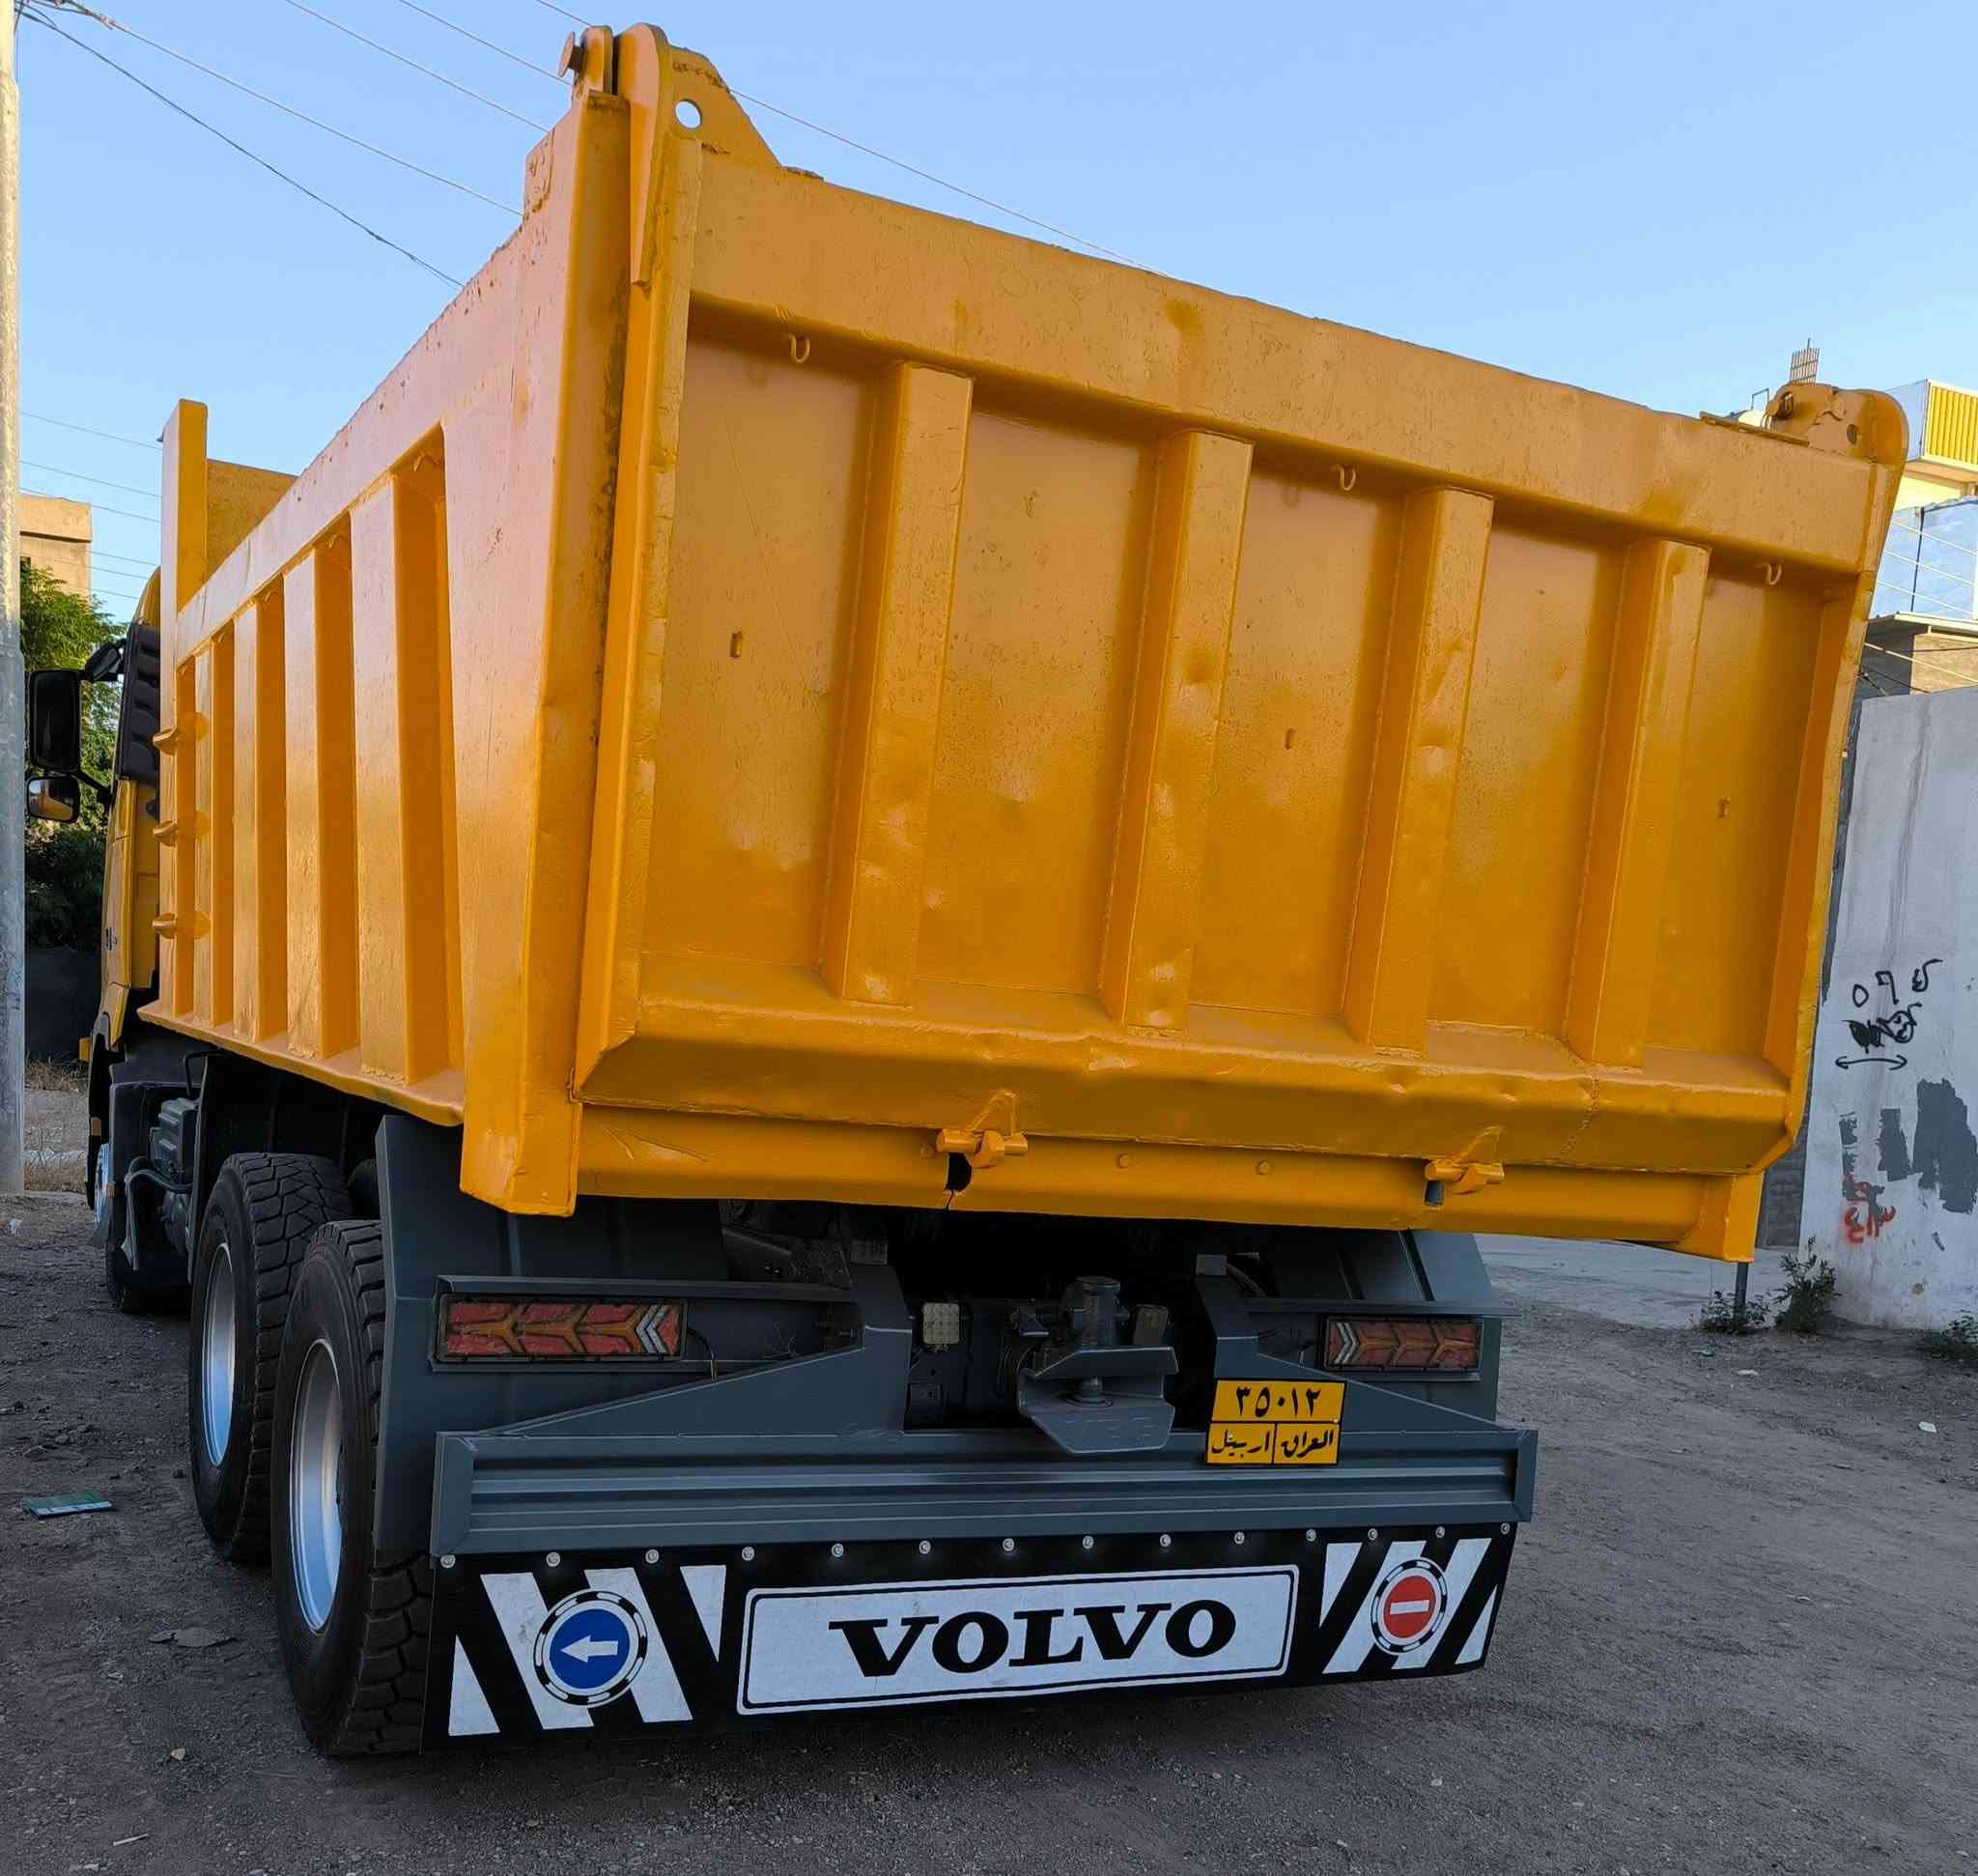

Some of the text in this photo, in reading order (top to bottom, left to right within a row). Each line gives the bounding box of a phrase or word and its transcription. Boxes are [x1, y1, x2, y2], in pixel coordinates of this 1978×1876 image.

[1235, 1385, 1322, 1418] ٣٥٠١٢
[1281, 1429, 1335, 1458] العراق
[828, 1599, 1236, 1678] VOLVO
